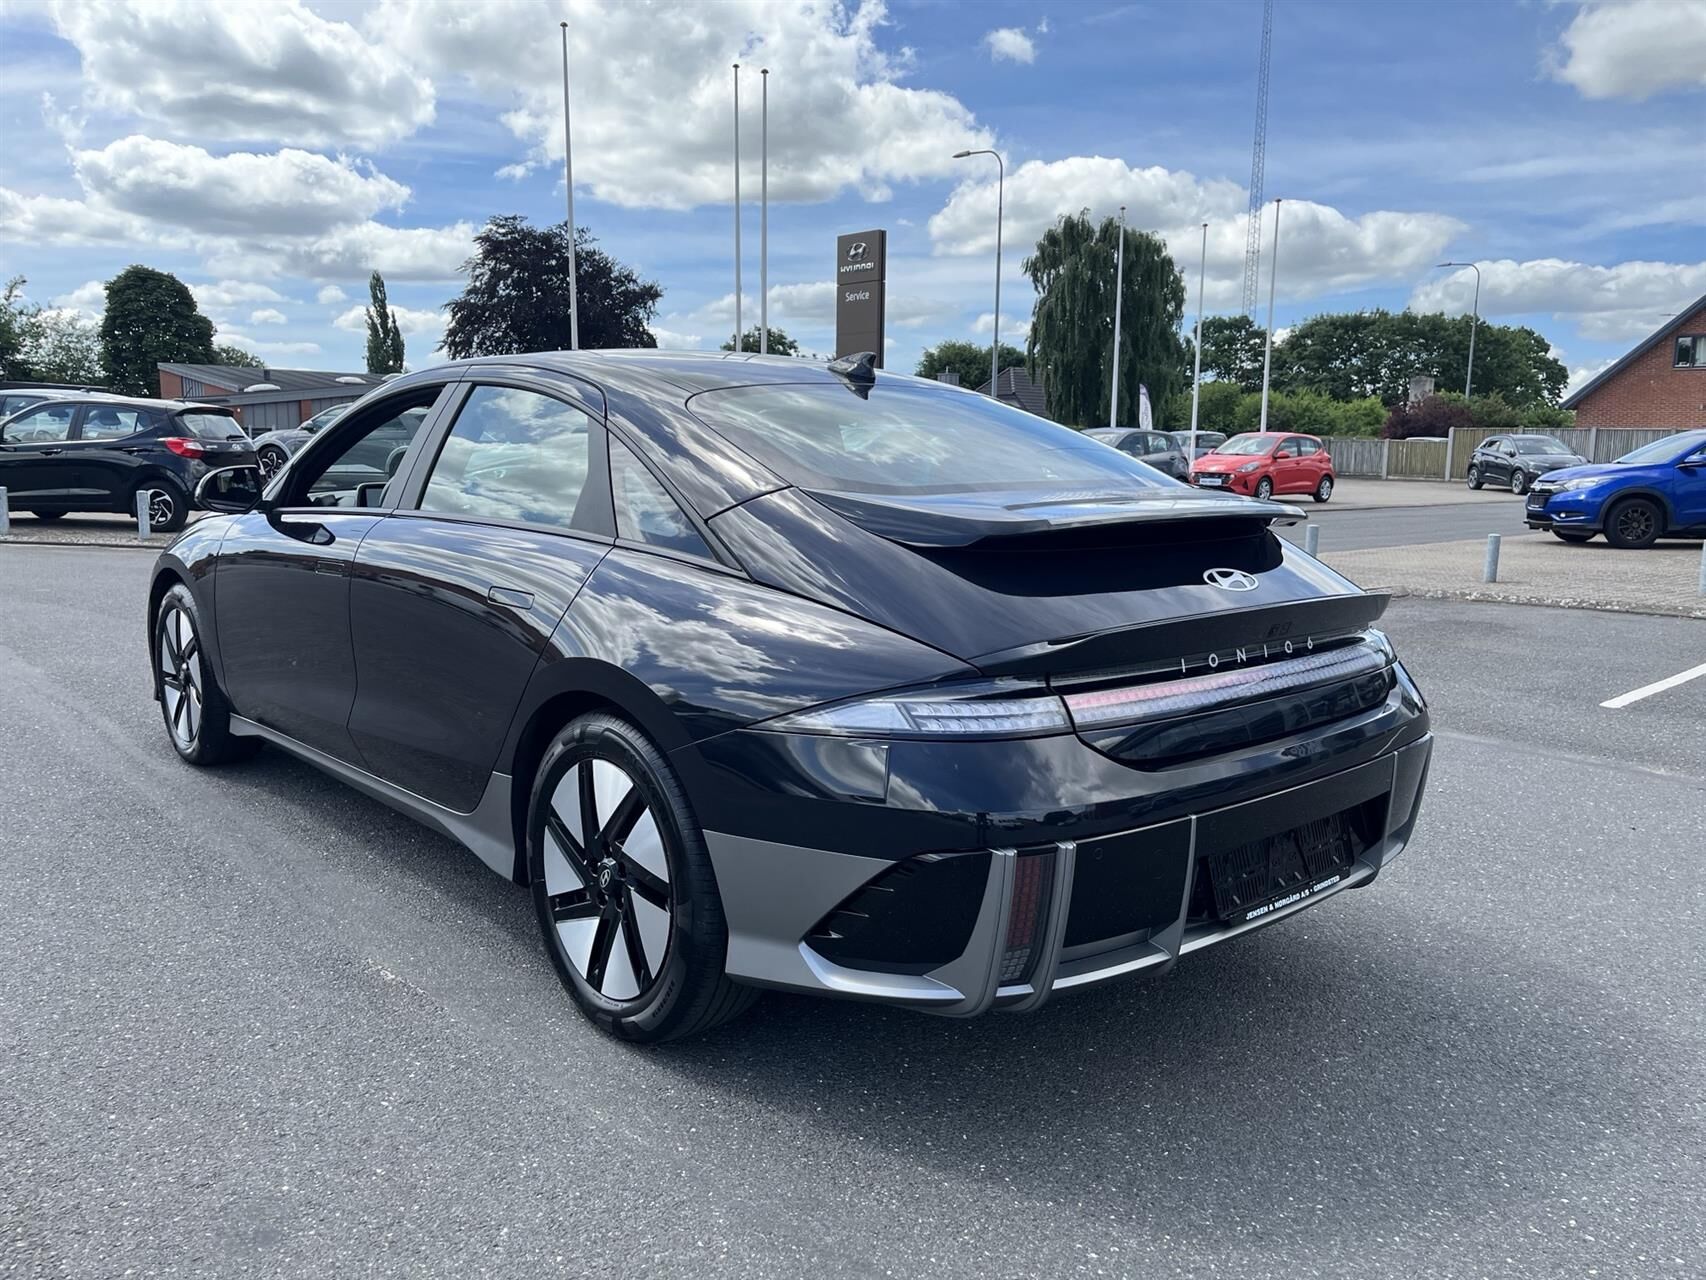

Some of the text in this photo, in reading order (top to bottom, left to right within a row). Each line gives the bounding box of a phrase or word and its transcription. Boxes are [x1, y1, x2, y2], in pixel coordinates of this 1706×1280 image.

[840, 262, 874, 273] HYUNDAI
[845, 291, 870, 303] Service
[1180, 636, 1314, 673] IONIQ 6
[1246, 905, 1269, 920] JENSEN
